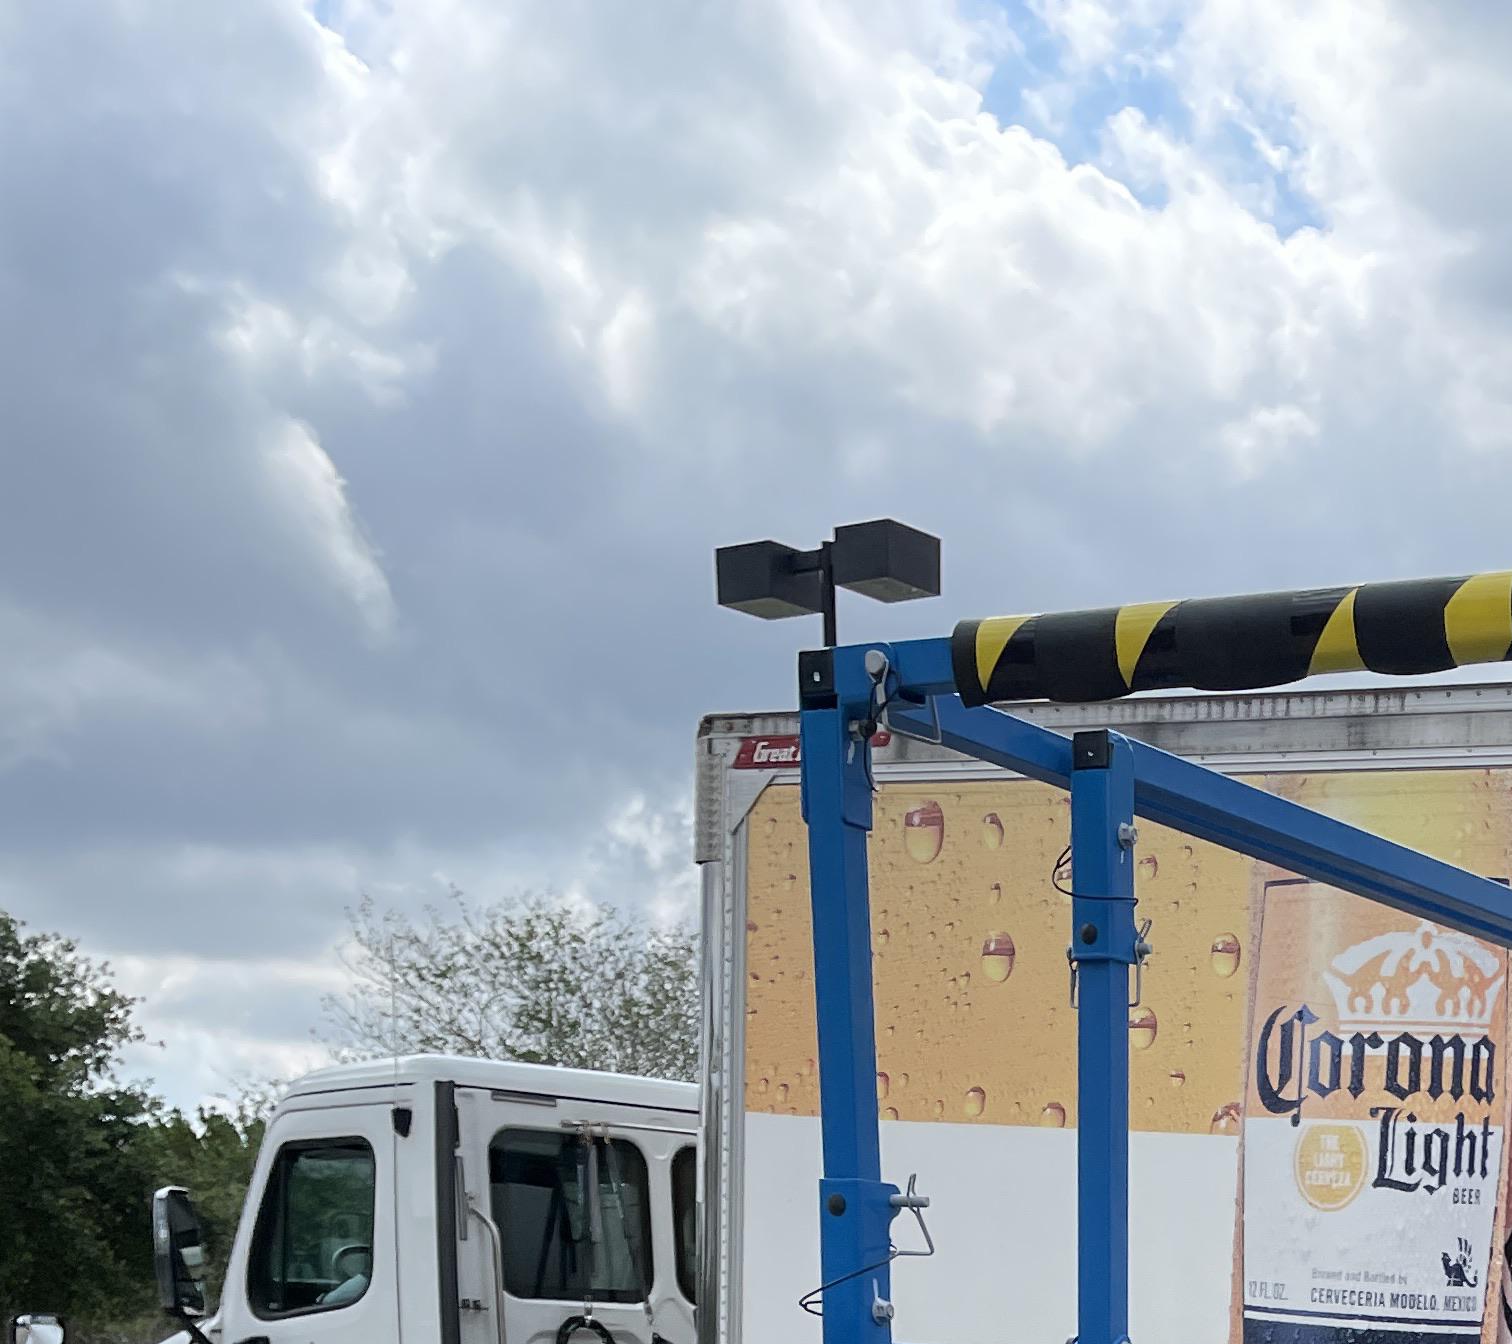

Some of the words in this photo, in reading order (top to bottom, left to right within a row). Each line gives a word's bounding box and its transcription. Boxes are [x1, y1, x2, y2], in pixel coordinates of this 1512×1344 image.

[1256, 1003, 1497, 1128] Corona
[1369, 1106, 1495, 1196] Light
[1452, 1187, 1481, 1205] BEER
[1310, 1287, 1386, 1308] CERVECERIA
